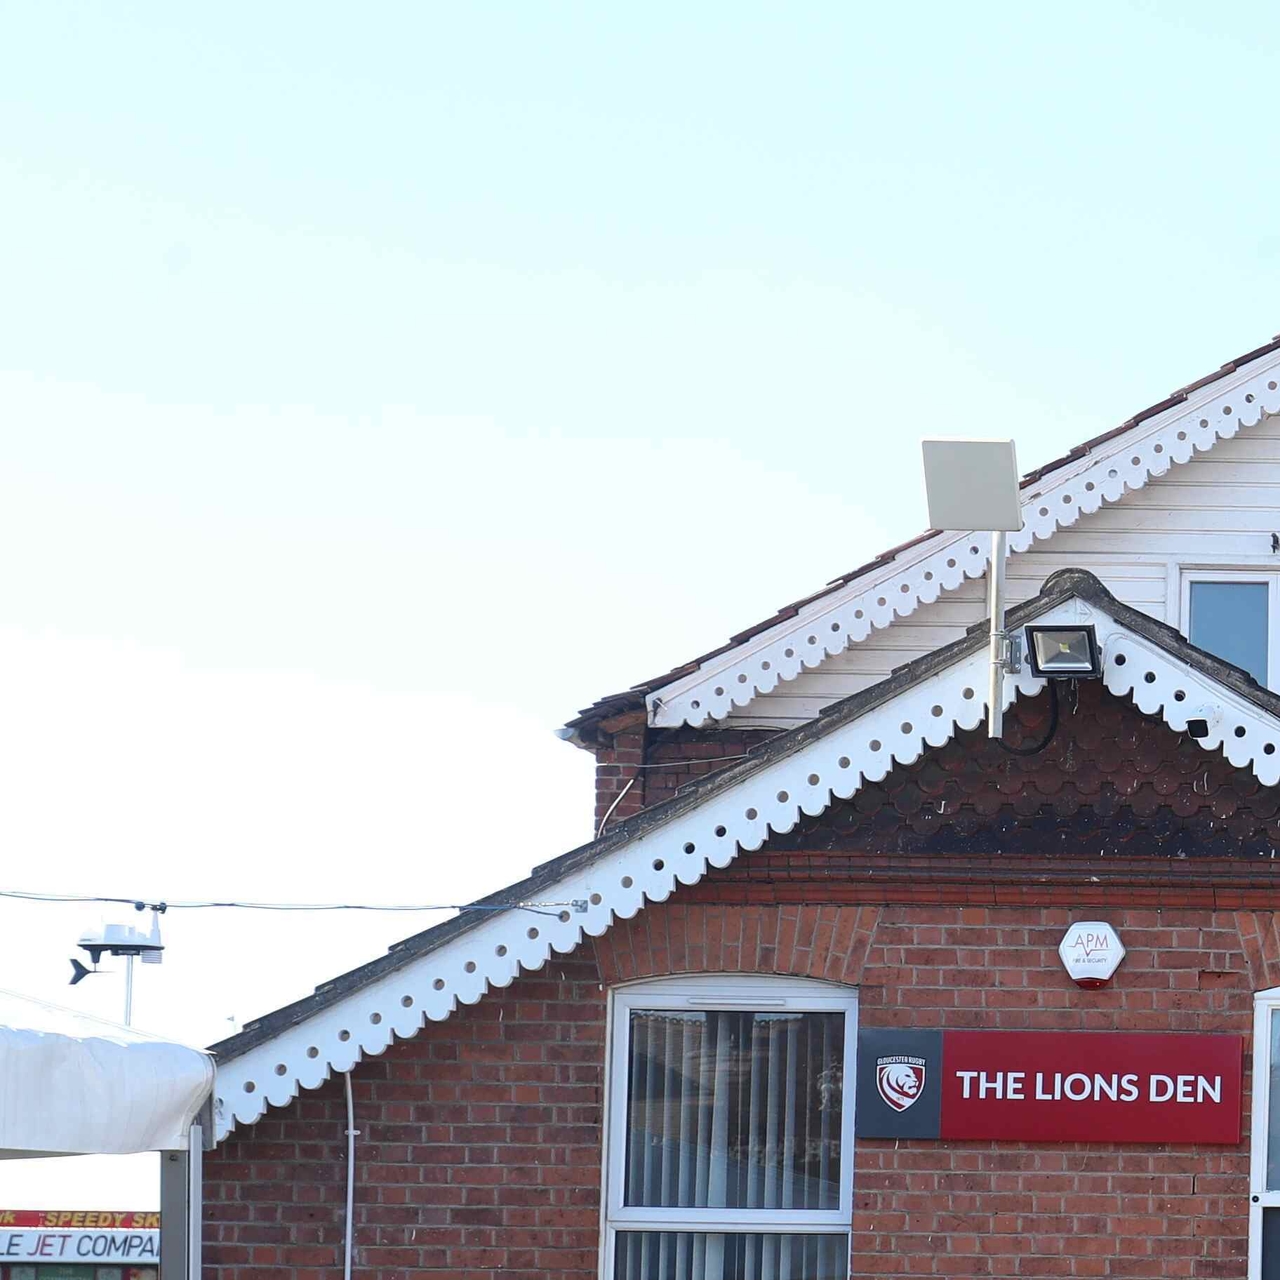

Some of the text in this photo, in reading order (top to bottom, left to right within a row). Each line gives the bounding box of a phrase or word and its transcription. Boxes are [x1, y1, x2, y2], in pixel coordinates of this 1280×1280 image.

[1072, 933, 1109, 955] APM
[877, 1056, 926, 1066] GLOUCESTER RUGBY
[956, 1071, 1221, 1103] THE LIONS DEN
[45, 1212, 126, 1227] SPEEDY
[0, 1234, 159, 1257] E JET COMPA
